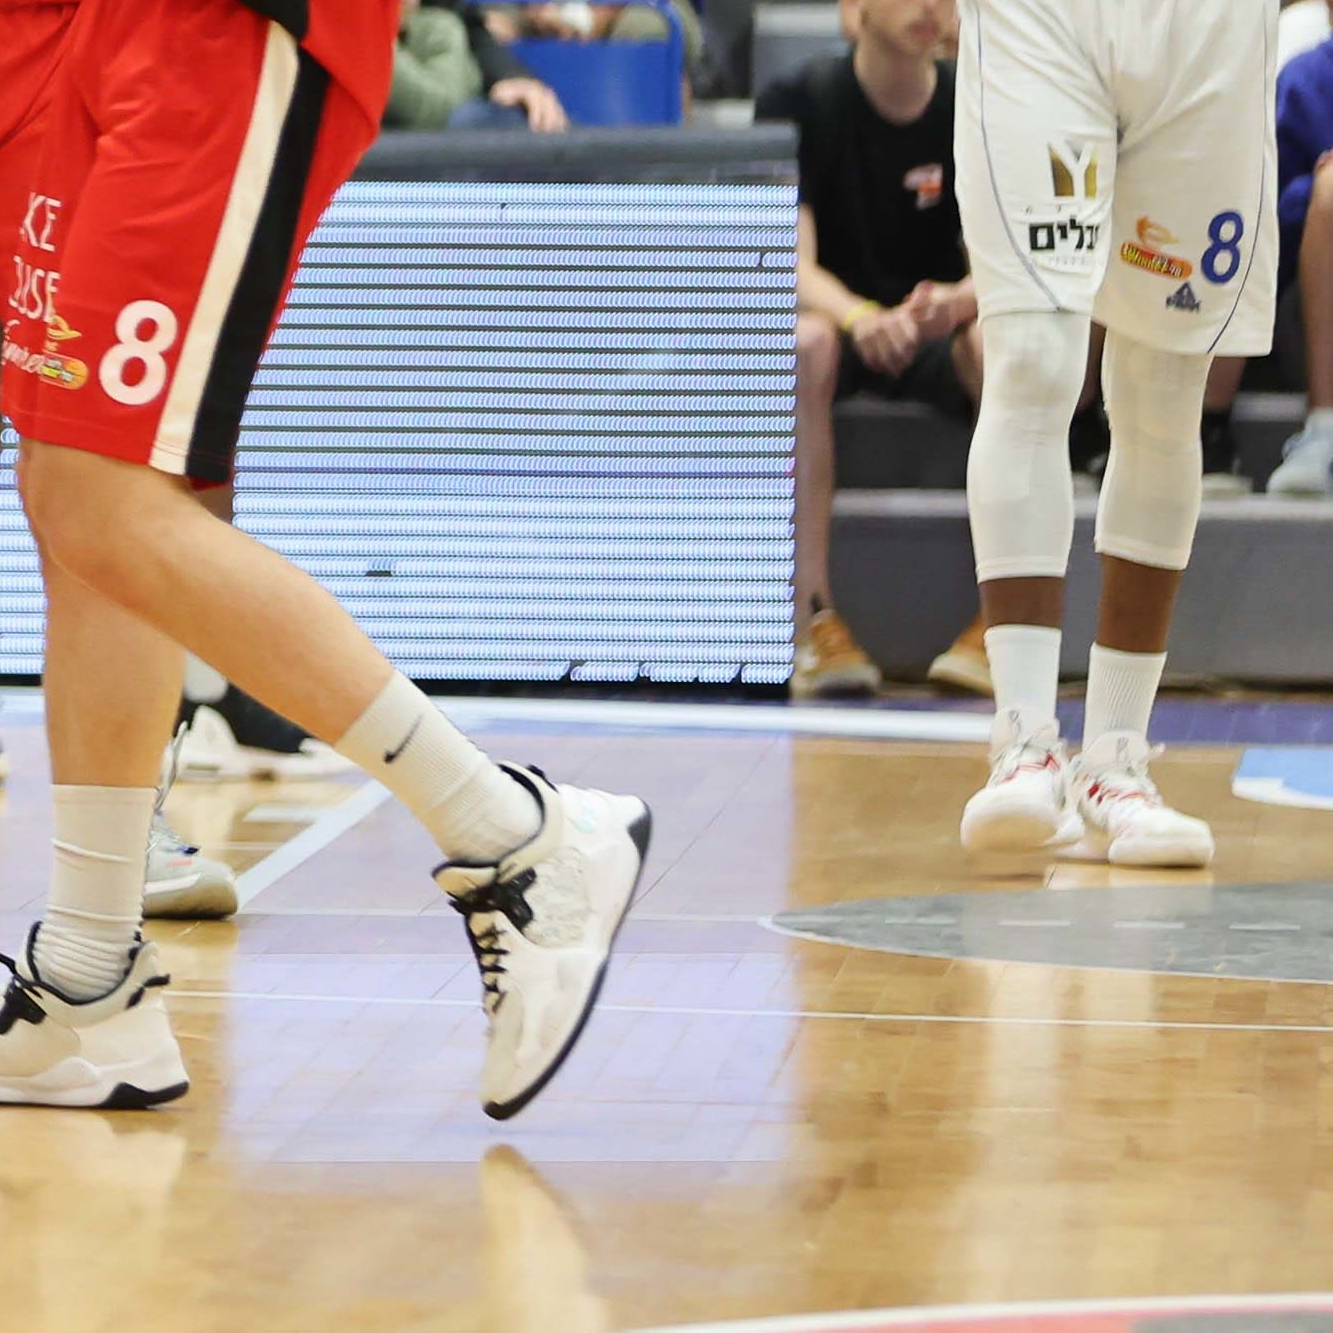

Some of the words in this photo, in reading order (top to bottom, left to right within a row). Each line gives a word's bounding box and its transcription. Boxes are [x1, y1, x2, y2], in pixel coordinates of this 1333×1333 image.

[19, 191, 62, 253] KE
[1200, 210, 1245, 285] 8
[98, 298, 179, 406] 8
